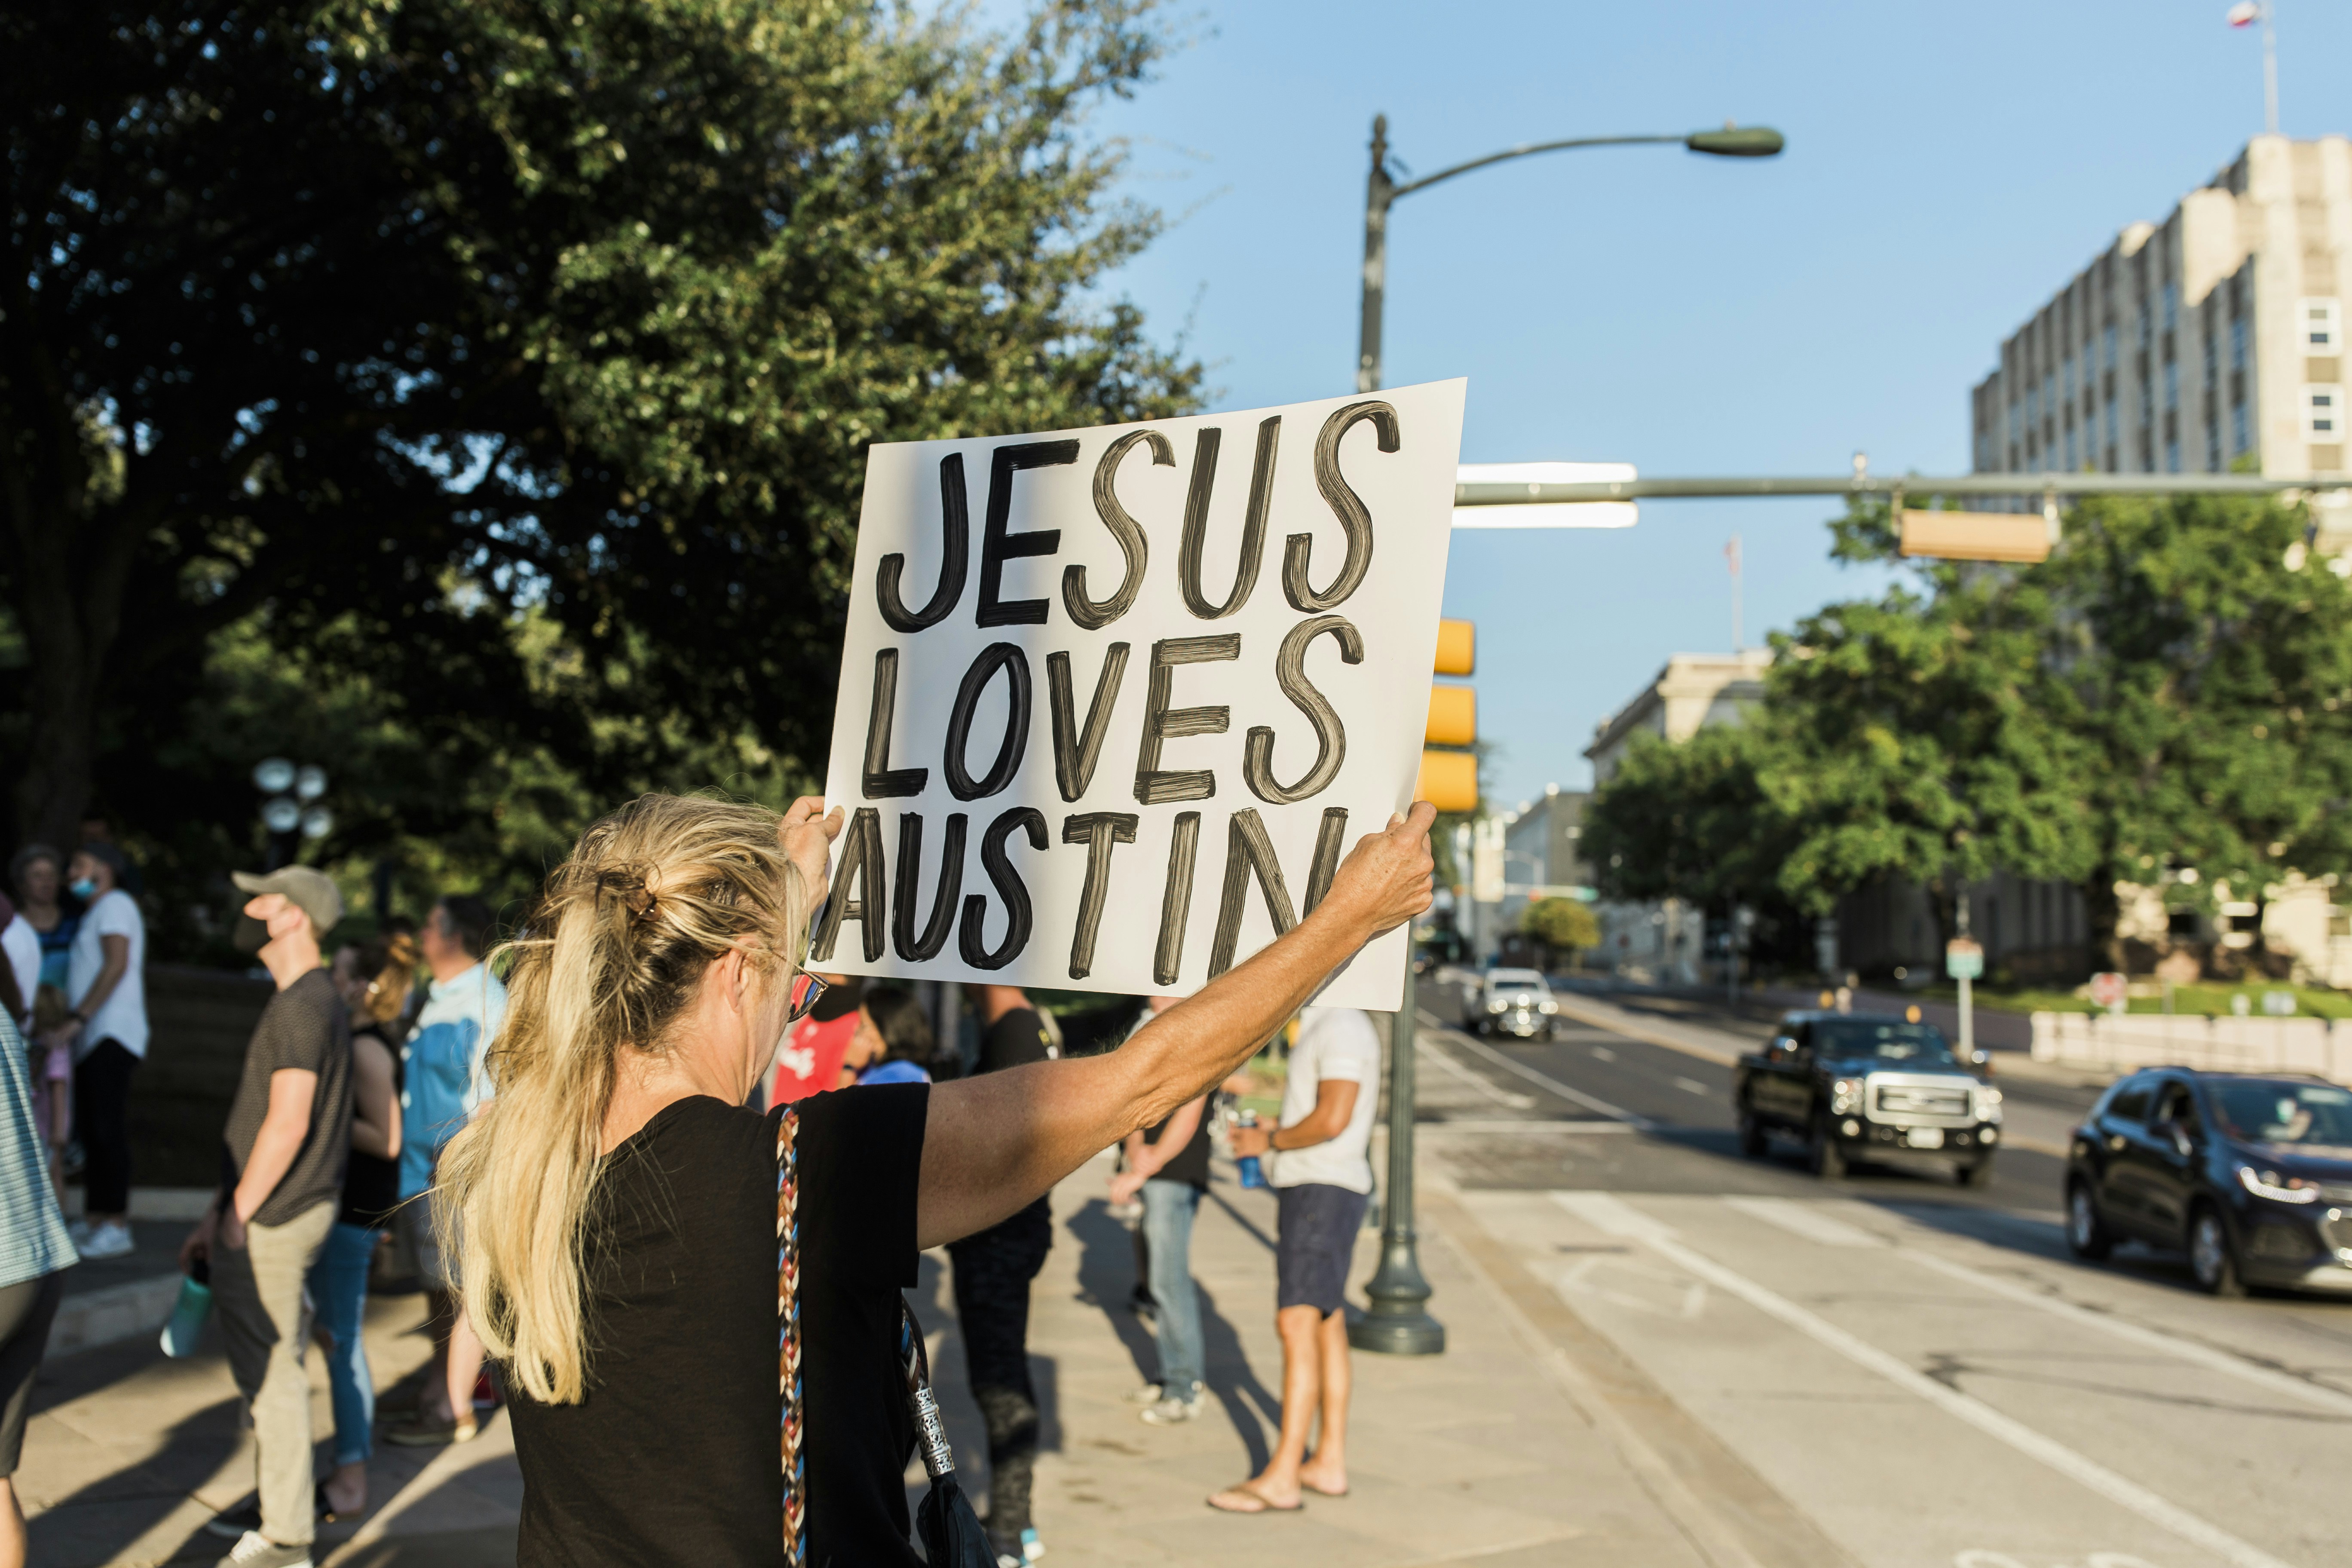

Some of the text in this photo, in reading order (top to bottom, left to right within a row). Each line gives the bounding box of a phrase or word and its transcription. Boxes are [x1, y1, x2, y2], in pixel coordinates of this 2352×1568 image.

[877, 401, 1400, 633] JESUS
[862, 615, 1363, 805] LOVES
[811, 807, 1348, 986] AUSTIN
